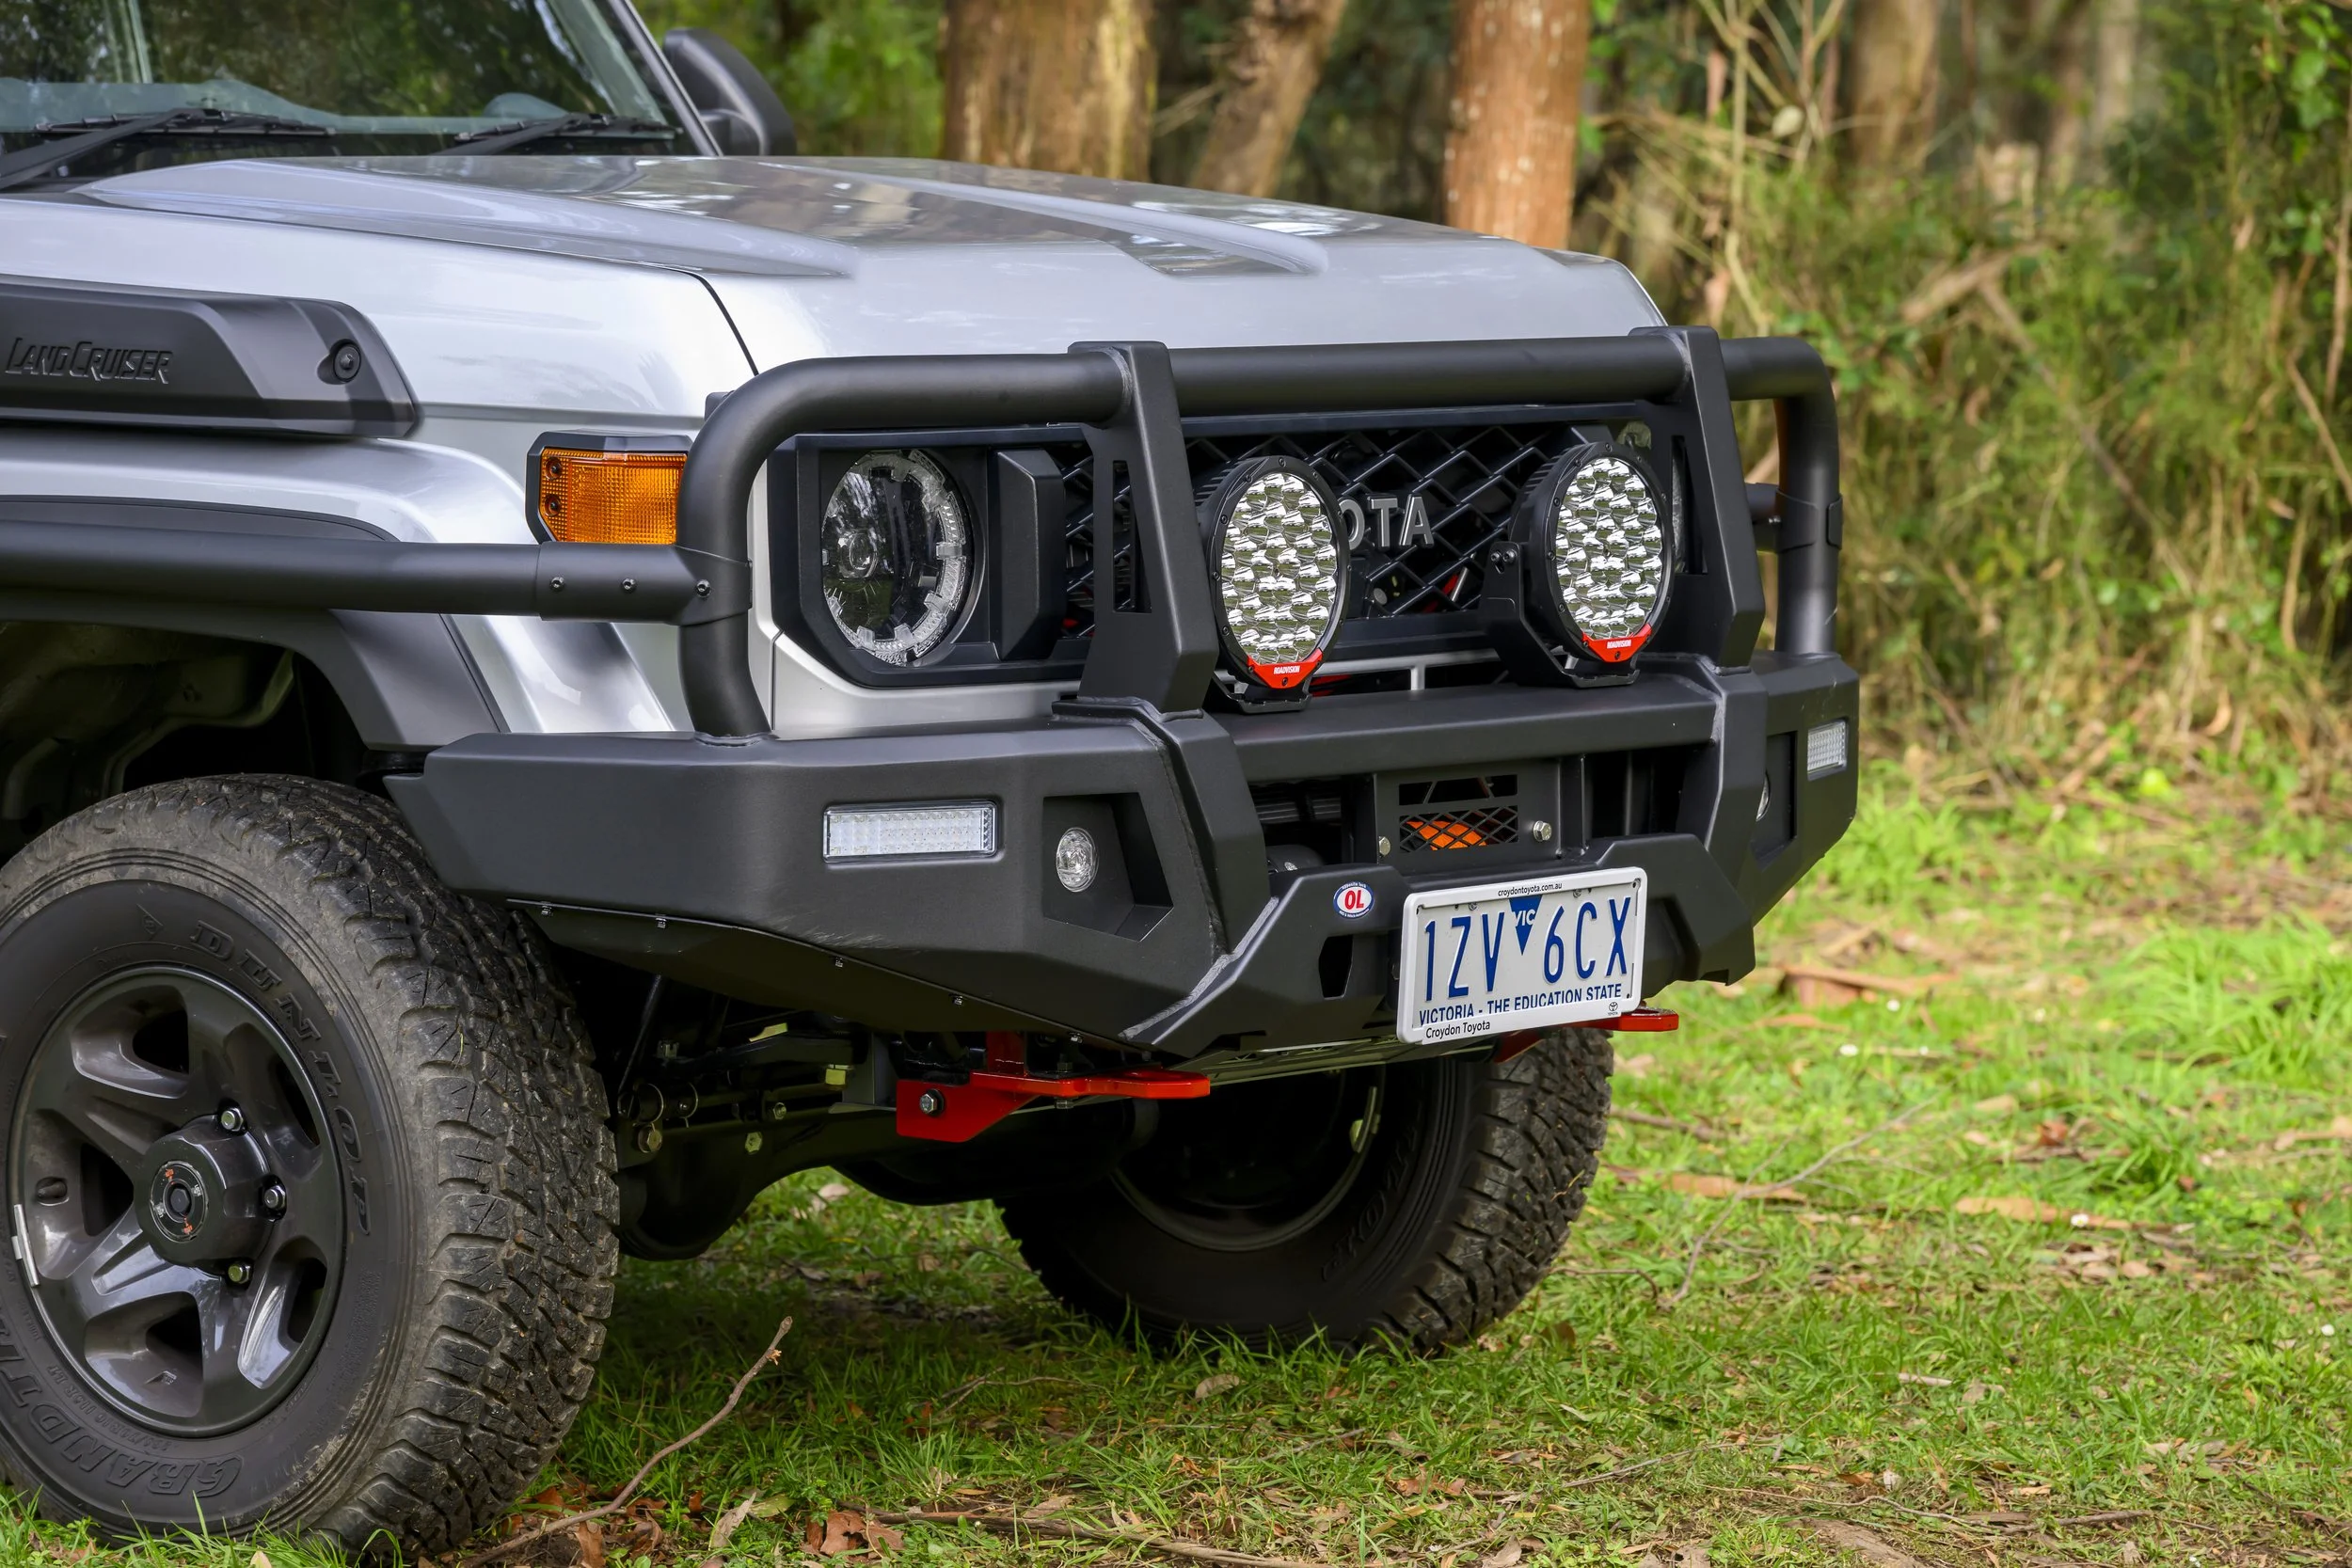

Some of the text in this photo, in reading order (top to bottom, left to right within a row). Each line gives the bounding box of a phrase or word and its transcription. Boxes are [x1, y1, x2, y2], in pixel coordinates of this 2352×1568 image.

[1273, 665, 1301, 675] ROADVISION
[1498, 882, 1563, 896] croydontoyota.com.au
[1344, 890, 1364, 910] OL
[1514, 909, 1535, 927] VIC
[1543, 896, 1631, 985] 6CX
[1424, 911, 1505, 1003] 1ZV
[1419, 1004, 1474, 1027] VICTORIA
[1487, 998, 1510, 1014] THE
[1514, 988, 1583, 1011] EDUCATION
[1586, 983, 1622, 1001] STATE
[1425, 1020, 1491, 1039] Croydon Toyota
[189, 919, 371, 1236] DUNLOP
